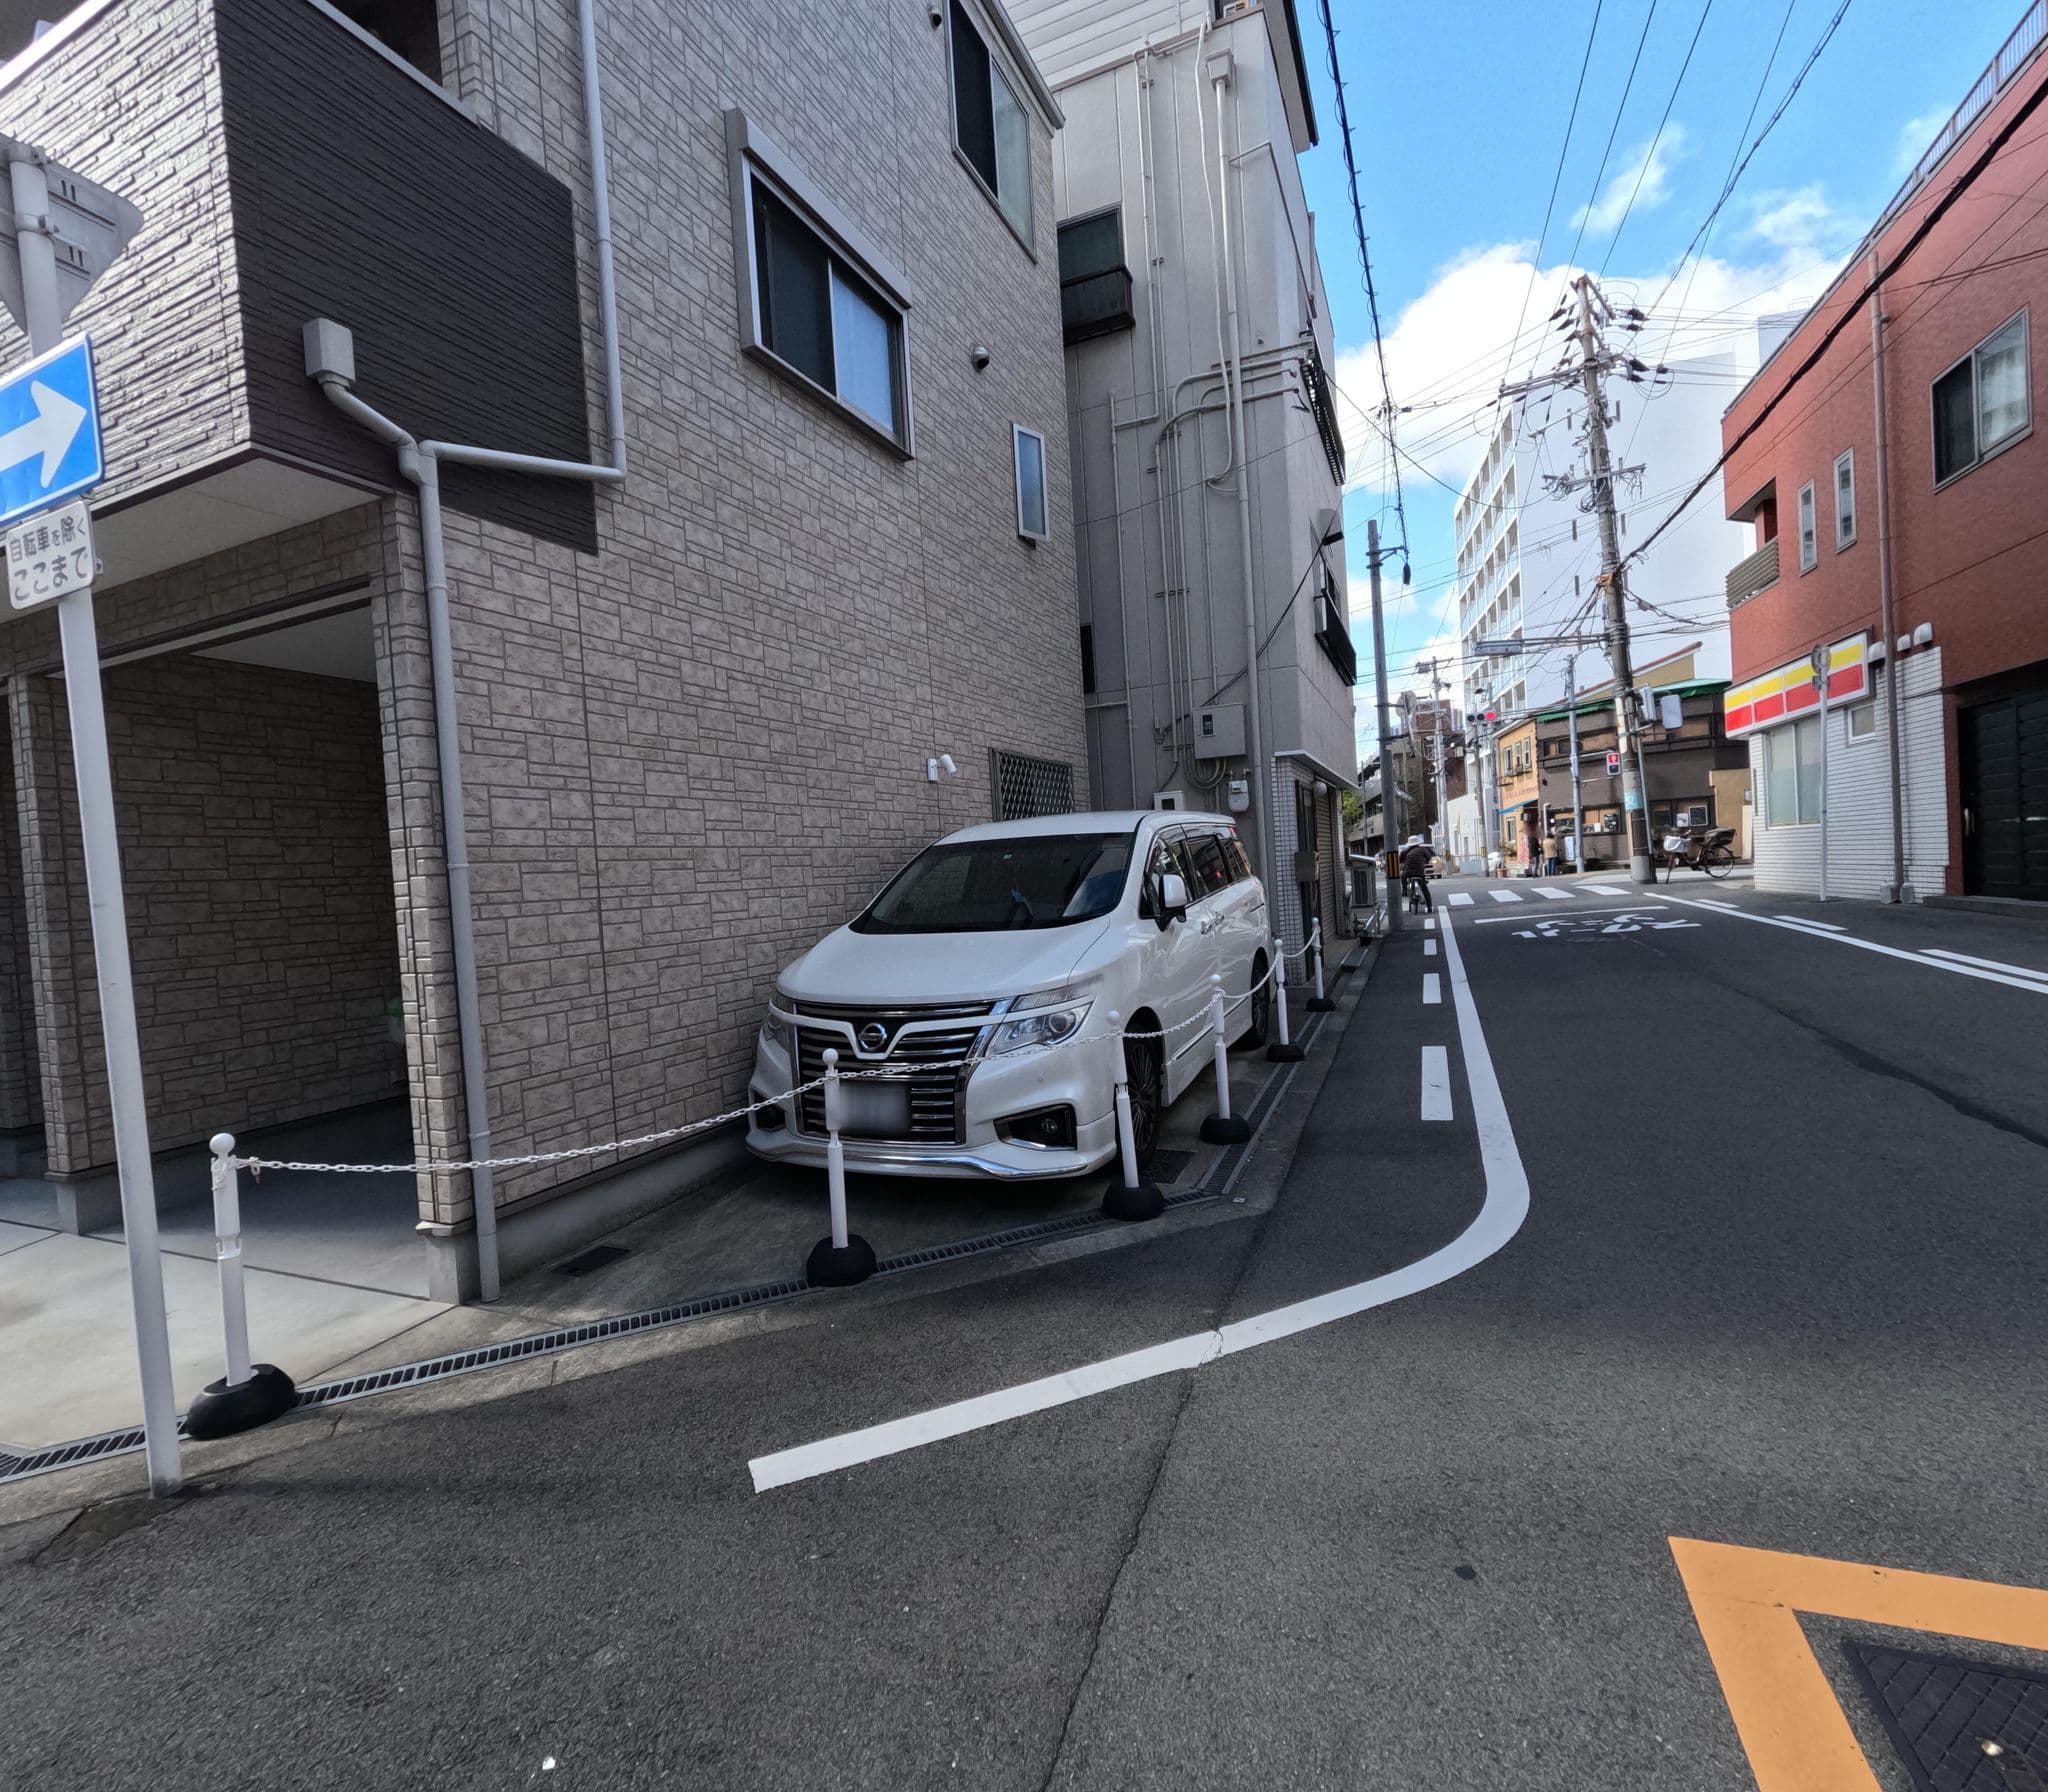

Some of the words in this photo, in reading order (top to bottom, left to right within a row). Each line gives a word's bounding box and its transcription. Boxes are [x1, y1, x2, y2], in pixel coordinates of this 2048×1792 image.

[10, 516, 86, 562] 自転車を除く
[14, 545, 88, 600] ここまで
